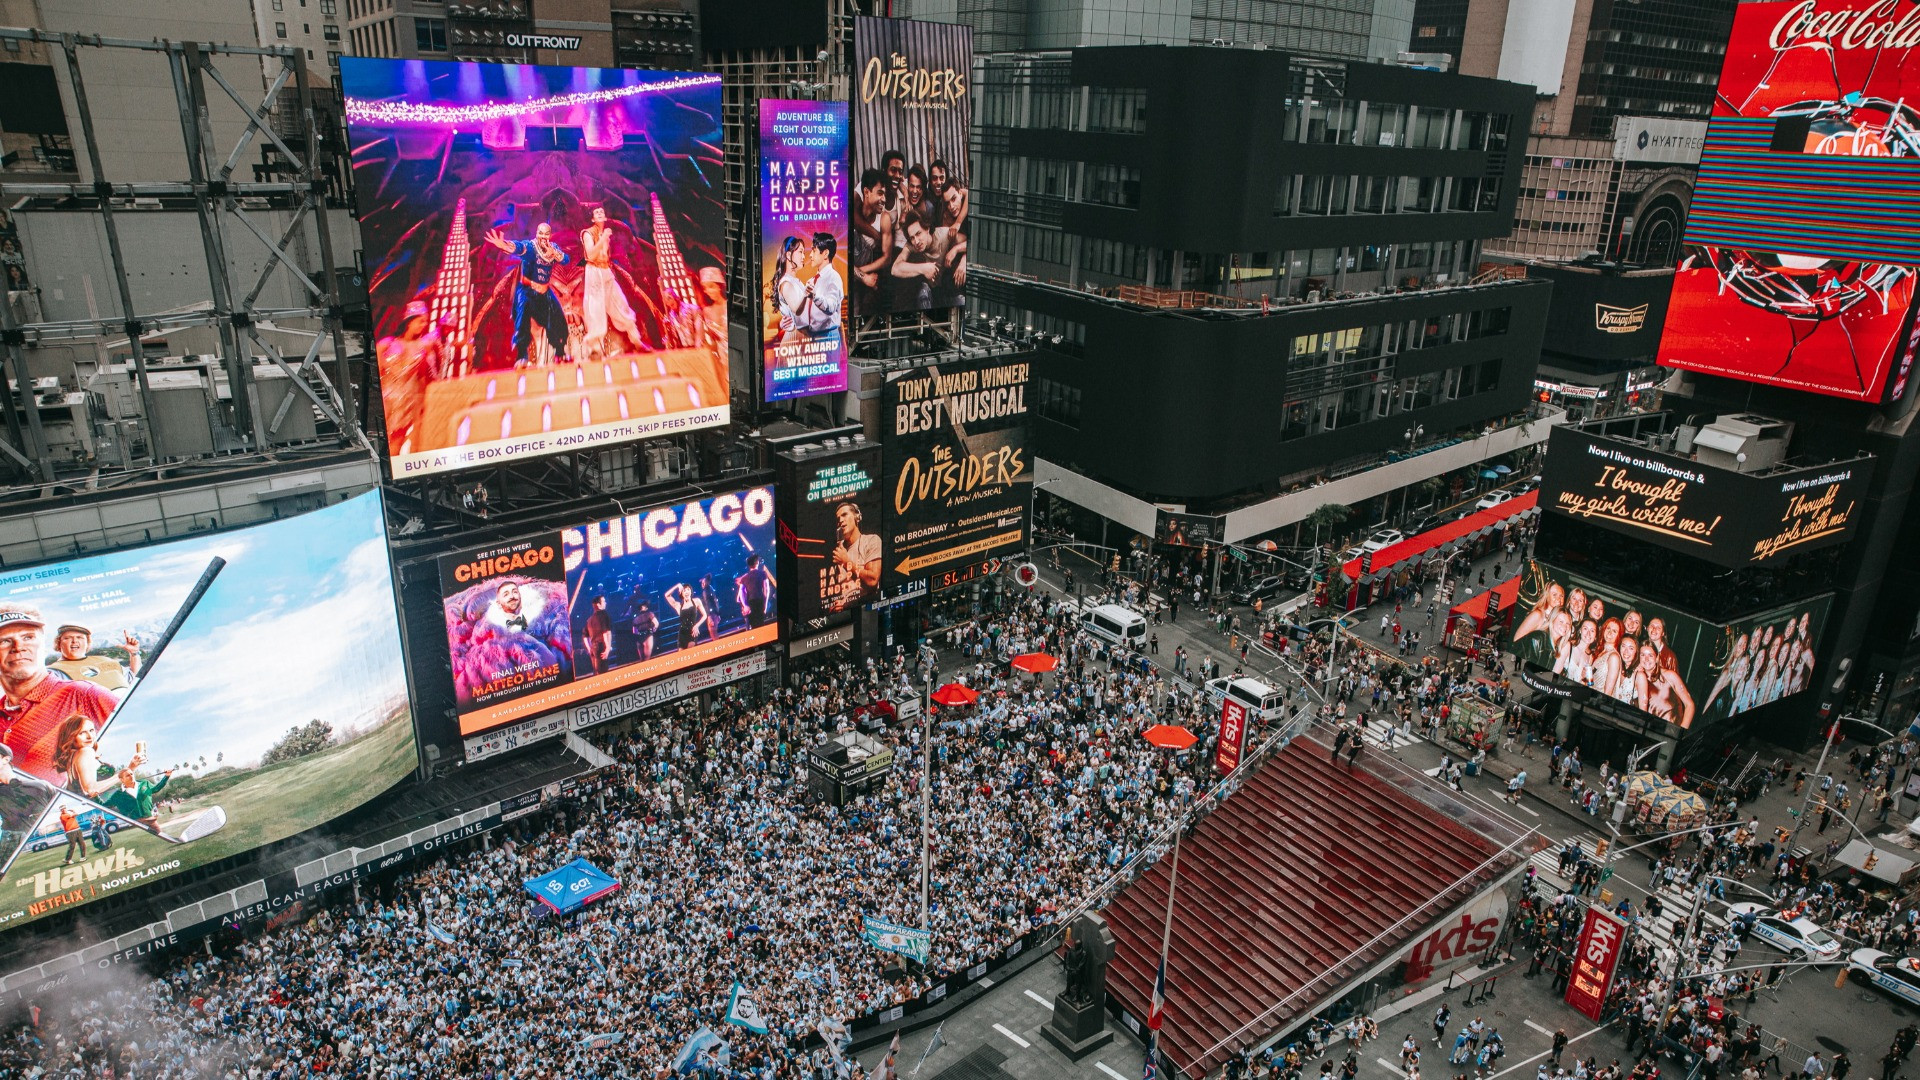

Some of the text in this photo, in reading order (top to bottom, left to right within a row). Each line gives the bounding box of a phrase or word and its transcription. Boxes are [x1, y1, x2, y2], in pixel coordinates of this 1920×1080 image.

[891, 52, 907, 68] THE
[862, 57, 966, 106] OUTSIDERS
[924, 101, 948, 110] MUSICAL
[776, 113, 822, 121] ADVENTURE
[774, 125, 837, 134] RIGHT OUTSIDE
[782, 137, 828, 146] YOUR DOOR
[1651, 136, 1684, 147] HYATT
[770, 161, 839, 177] MAYBE
[770, 179, 839, 194] HAPPY
[771, 196, 839, 212] ENDING
[774, 341, 839, 357] TONY AWARD
[786, 354, 827, 367] WINNER
[773, 363, 840, 380] BEST MUSICAL
[897, 363, 1030, 402] TONY AWARD WINNER!
[896, 385, 1027, 436] BEST MUSICAL
[405, 413, 720, 471] BUY AT BOX OFFICE 42ND AND 7TH. SKIP FEES TODAY.
[932, 445, 952, 463] THE
[838, 463, 857, 474] BEST
[1588, 444, 1705, 484] Now I live on billboards &
[810, 471, 867, 490] NEW MUSICAL
[895, 446, 1024, 515] OUTSIDERS
[1595, 465, 1687, 506] I brought
[1782, 483, 1796, 492] Now
[1799, 479, 1809, 489] live
[1818, 472, 1846, 485] billboards
[807, 491, 819, 501] ON
[947, 487, 1002, 507] A NEW MUSICAL
[1782, 484, 1840, 522] I brought
[1559, 491, 1722, 536] my girls with me!
[563, 488, 774, 571] CHICAGO
[894, 534, 905, 544] ON
[907, 523, 948, 540] BROADWAY
[958, 506, 1022, 527] OutsidersMusical.com
[1754, 500, 1854, 560] my girls with me!
[477, 552, 488, 560] SEE
[497, 547, 510, 555] THIS
[512, 542, 532, 551] WEEK!
[933, 552, 951, 561] BLOCKS
[1000, 534, 1018, 542] THEATRE
[35, 567, 70, 579] SERIES
[454, 546, 554, 582] CHICAGO
[820, 560, 860, 578] MAYBE
[35, 581, 59, 589] TATRO
[73, 573, 104, 582] FORTUNE
[820, 570, 860, 588] HAPPY
[81, 590, 125, 603] ALL HAIL
[101, 597, 131, 608] HAWK
[491, 660, 539, 680] FINAL WEEK!
[498, 699, 545, 716] AMBASSADOR
[548, 690, 575, 701] THEATRE
[624, 664, 658, 678] BROADWAY
[728, 638, 748, 648] OFFICE
[688, 668, 715, 679] DISCOUNT
[472, 664, 560, 697] MATTEO LANE
[493, 685, 520, 697] THROUGH
[522, 682, 534, 690] JULY
[543, 675, 557, 684] ONLY
[687, 679, 717, 690] SOUVENIRS
[1534, 680, 1553, 693] family
[576, 679, 679, 726] GRAND SLAM
[482, 720, 537, 742] SPORTS FAN SHOP
[1225, 705, 1242, 742] tkts
[810, 754, 838, 777] KLIKTIX
[844, 755, 891, 778] TICKET CENTER
[15, 876, 34, 887] the
[34, 847, 138, 898] Hawk
[222, 889, 305, 926] AMERICAN
[314, 869, 359, 892] EAGLE
[381, 852, 403, 868] aerie
[424, 822, 482, 850] OFFLINE
[11, 911, 24, 920] ON
[28, 888, 84, 916] NETFLIX
[101, 876, 130, 891] NOW
[133, 860, 181, 881] PLAYING
[548, 880, 564, 892] GO!
[570, 878, 591, 892] GO!
[1755, 925, 1774, 938] NYPD
[896, 946, 917, 956] JUAN
[1586, 918, 1616, 965] tkts
[37, 934, 178, 992] aerie OFFLINE
[1878, 976, 1898, 990] NYPD
